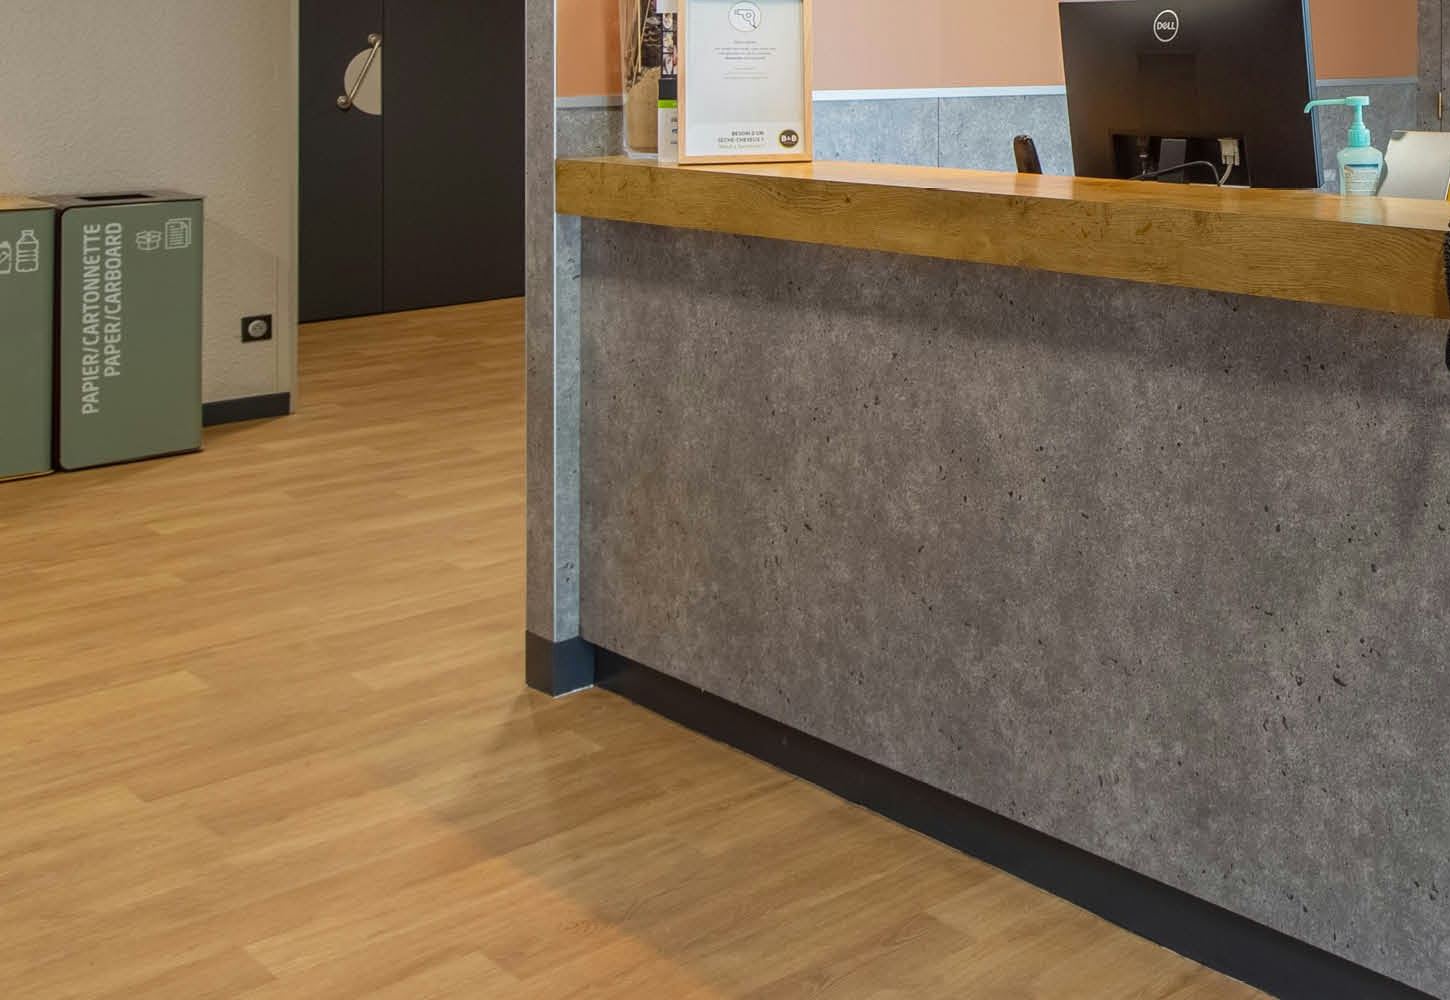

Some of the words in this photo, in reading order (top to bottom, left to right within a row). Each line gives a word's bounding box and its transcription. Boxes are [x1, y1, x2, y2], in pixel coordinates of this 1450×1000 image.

[1156, 21, 1176, 31] DELL
[81, 222, 101, 416] PAPIER/CARTONNETTE
[103, 221, 123, 378] PAPER/CARBOARD
